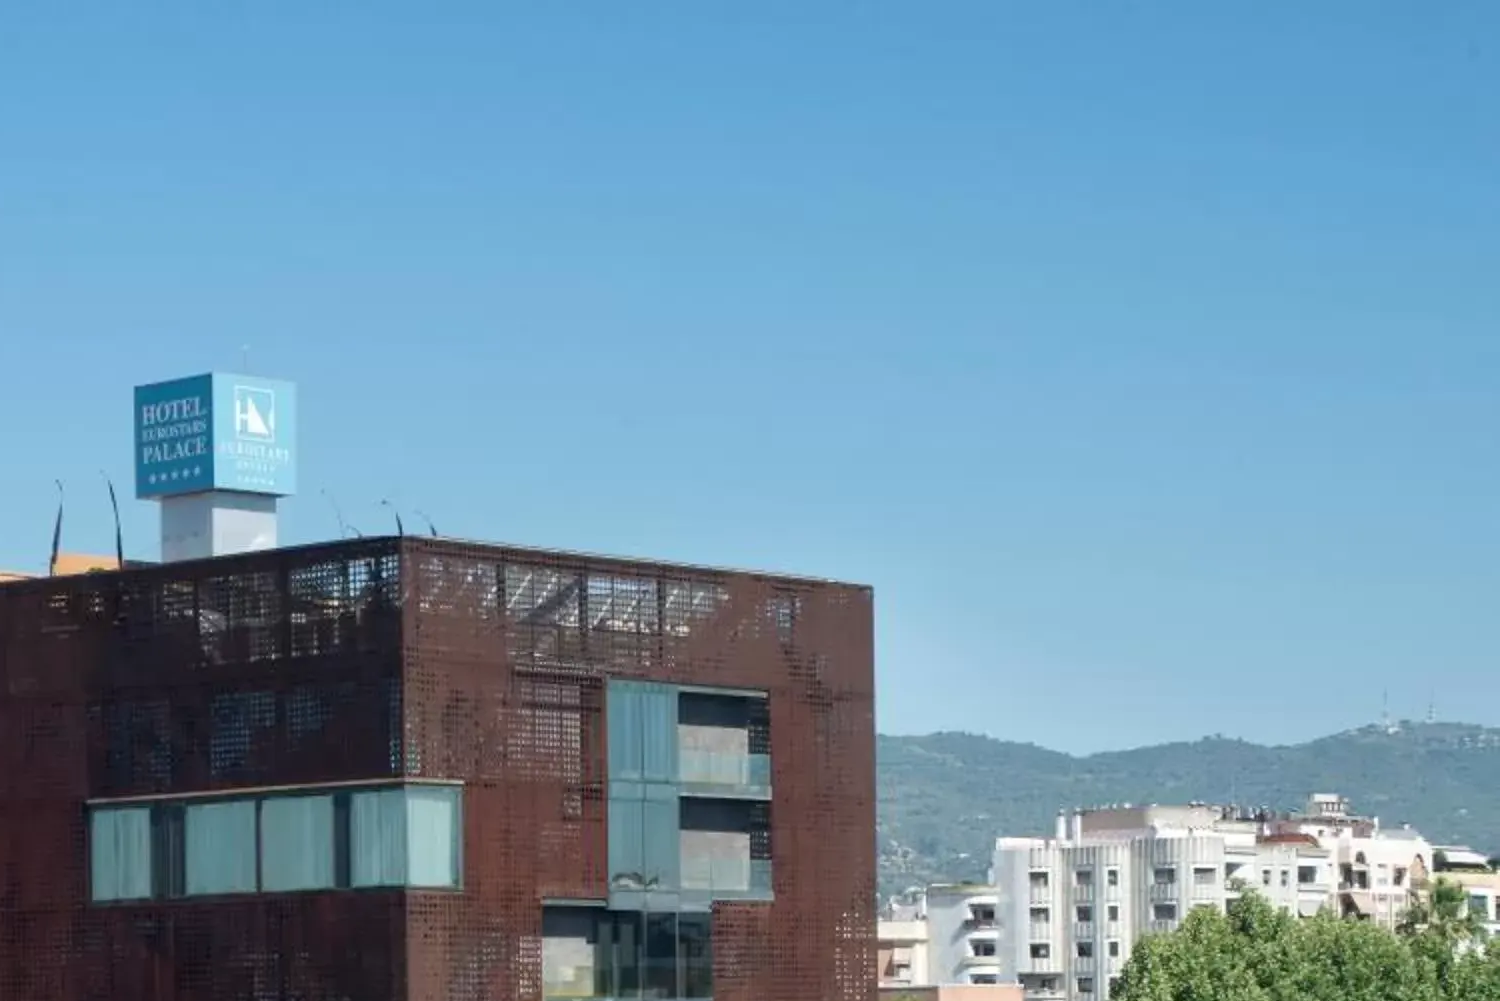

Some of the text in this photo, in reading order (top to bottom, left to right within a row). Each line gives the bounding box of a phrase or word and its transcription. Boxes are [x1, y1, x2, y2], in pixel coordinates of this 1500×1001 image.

[142, 396, 208, 426] HOTEL
[142, 418, 207, 443] EUROSTARS
[142, 435, 208, 464] PALACE
